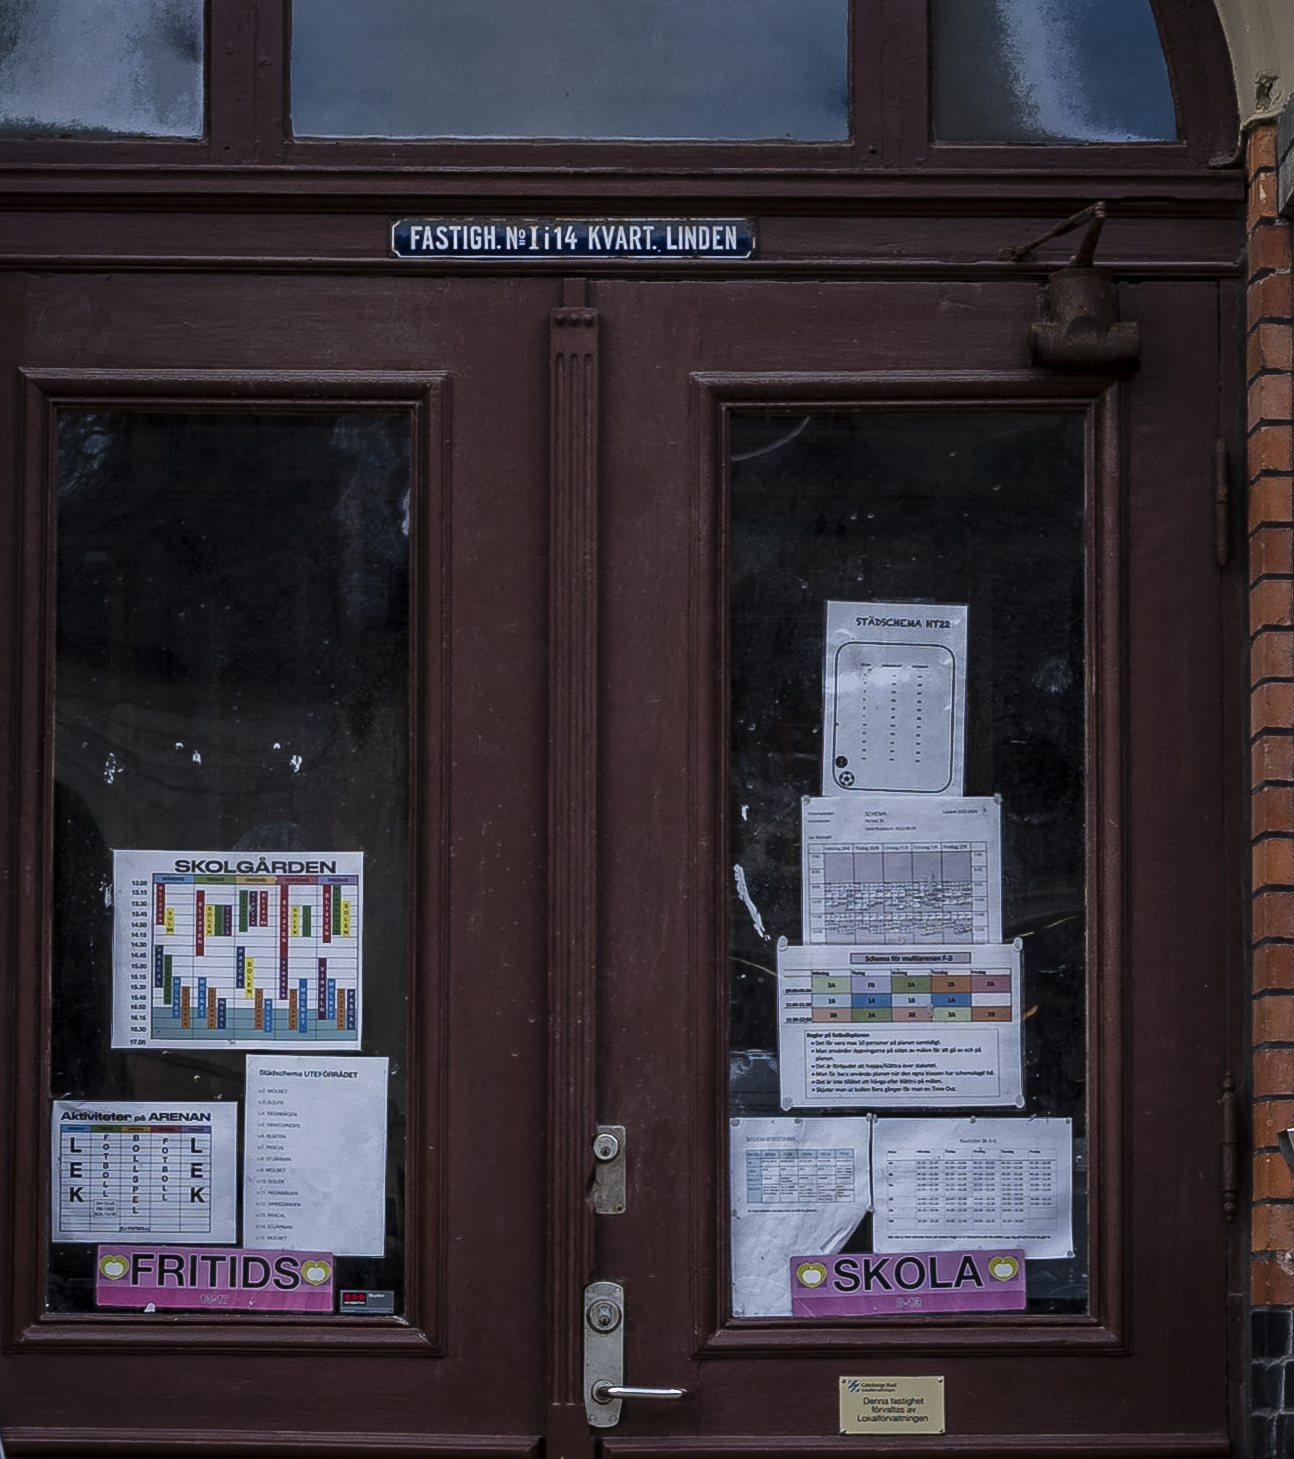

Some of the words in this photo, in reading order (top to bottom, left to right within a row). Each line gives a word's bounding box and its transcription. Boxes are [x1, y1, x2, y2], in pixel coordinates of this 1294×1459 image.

[410, 225, 502, 250] FASTIGH.
[554, 226, 578, 250] 14
[588, 225, 658, 251] KVART.
[666, 225, 738, 250] LINDEN
[856, 616, 922, 628] STÄDSCHEMA
[926, 619, 951, 629] HT22
[174, 856, 336, 874] SKOLGÅRDEN
[60, 1111, 132, 1121] Aktiviteter
[148, 1113, 211, 1122] ARENAN
[131, 1254, 302, 1290] FRITIDS
[834, 1255, 984, 1292] SKOLA
